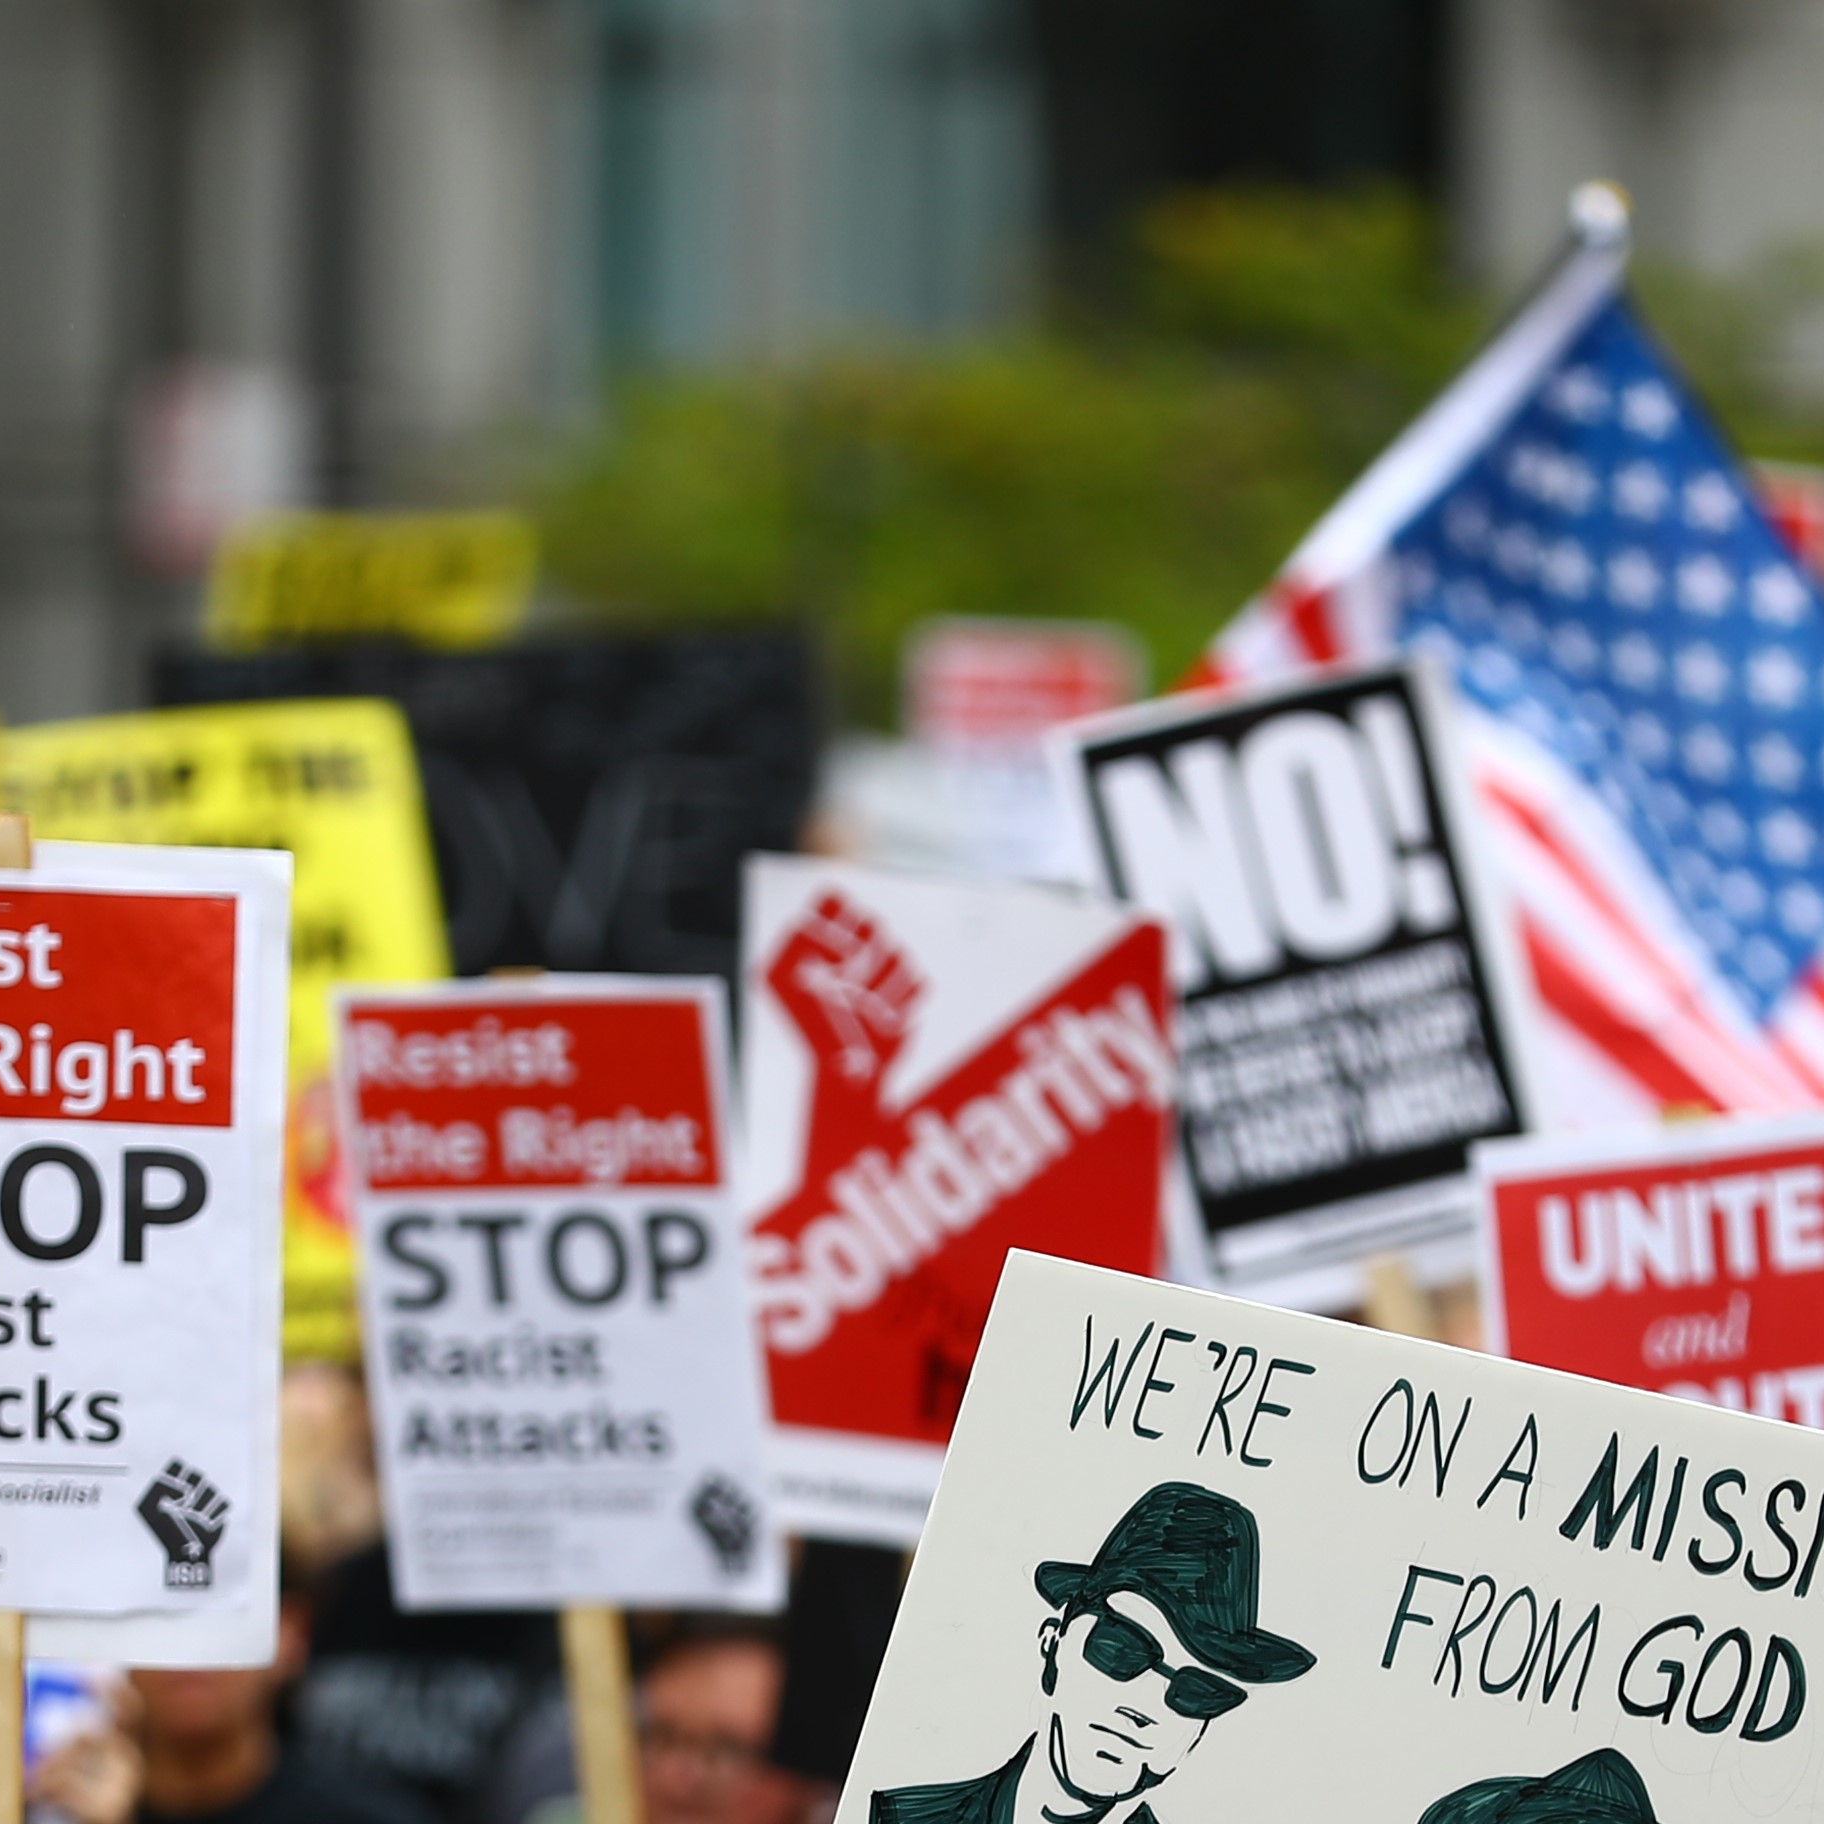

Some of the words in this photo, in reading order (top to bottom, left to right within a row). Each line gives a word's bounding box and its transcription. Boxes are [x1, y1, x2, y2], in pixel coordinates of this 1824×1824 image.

[1097, 700, 1460, 983] NO!
[348, 1018, 577, 1086] Resist
[359, 1111, 487, 1180] the
[504, 1106, 707, 1190] Right
[746, 984, 1171, 1355] Solidarity
[380, 1208, 712, 1312] STOP
[387, 1326, 608, 1390] Racist
[1641, 1290, 1752, 1370] and
[400, 1400, 674, 1464] Attacks
[1069, 1313, 1316, 1469] WE'RE
[1357, 1378, 1473, 1498] ON
[1478, 1413, 1540, 1520] A
[1380, 1564, 1597, 1713] FROM
[1617, 1614, 1808, 1743] GOD
